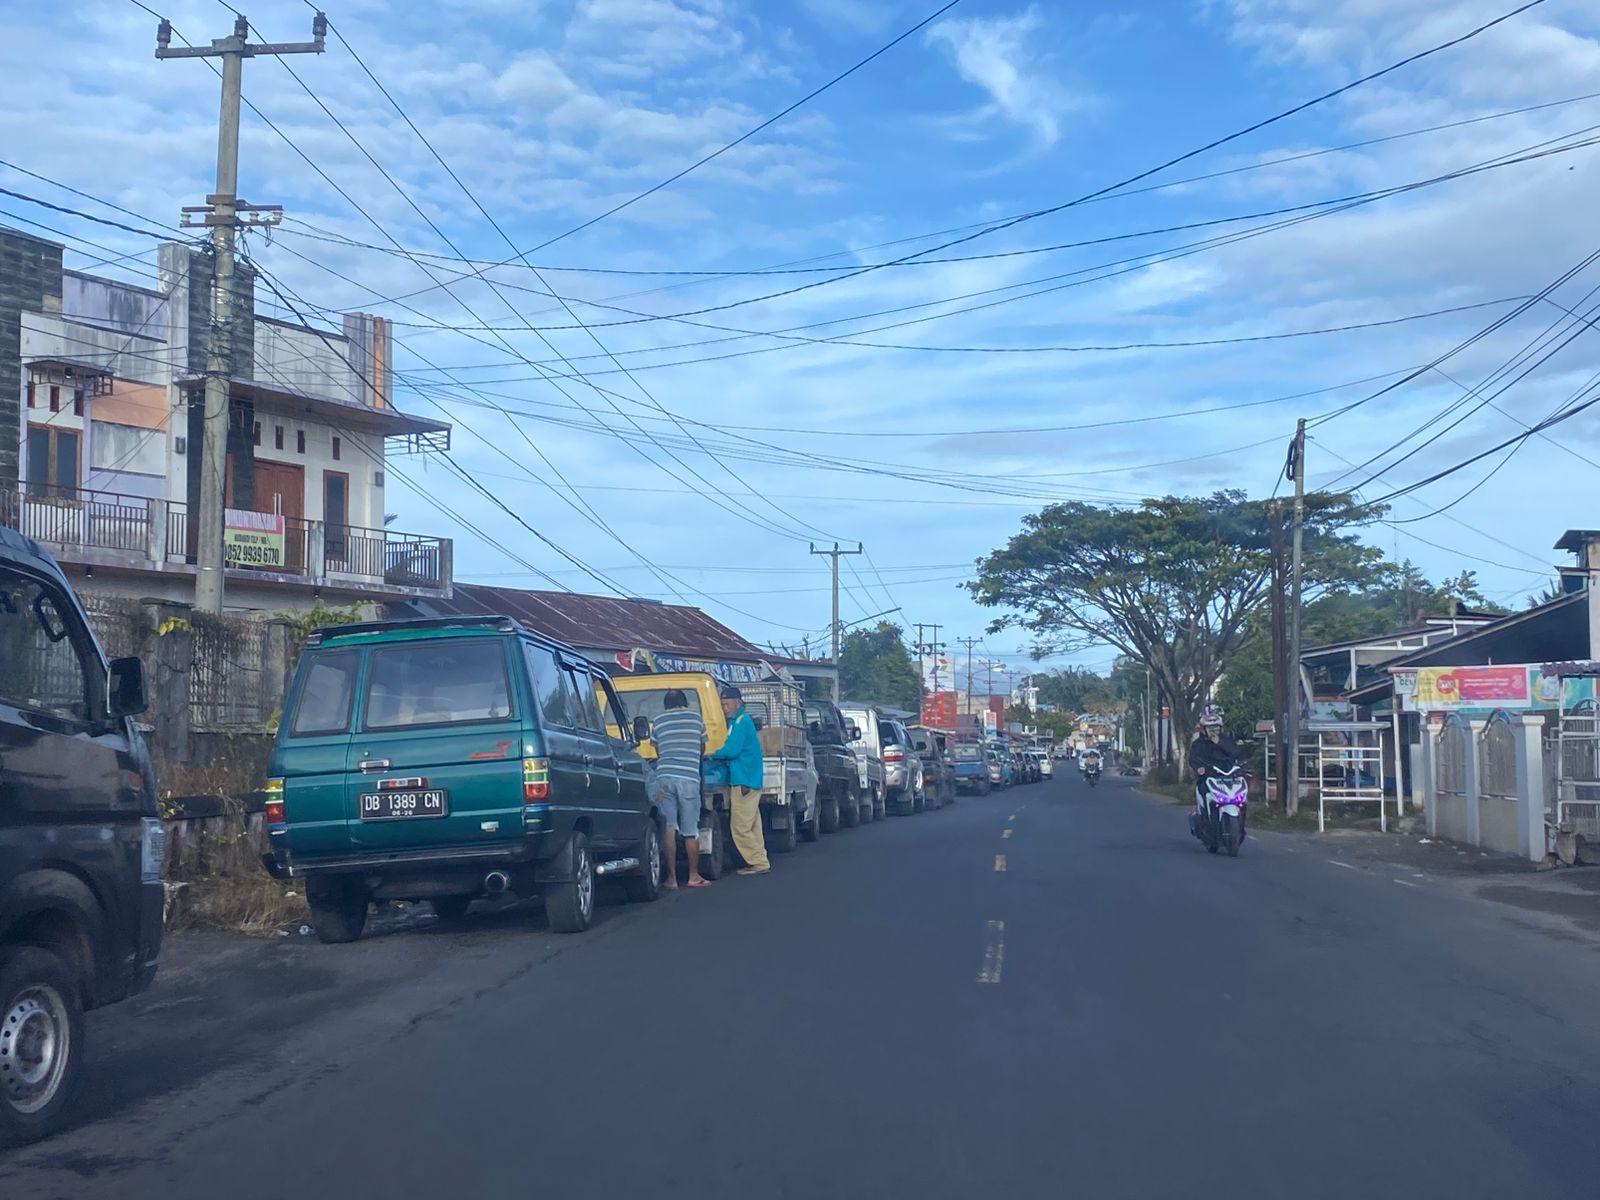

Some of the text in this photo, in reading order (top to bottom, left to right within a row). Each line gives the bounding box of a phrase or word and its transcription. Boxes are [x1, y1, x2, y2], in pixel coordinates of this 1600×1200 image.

[243, 545, 262, 562] 9939
[365, 793, 440, 811] DB 1389 CN
